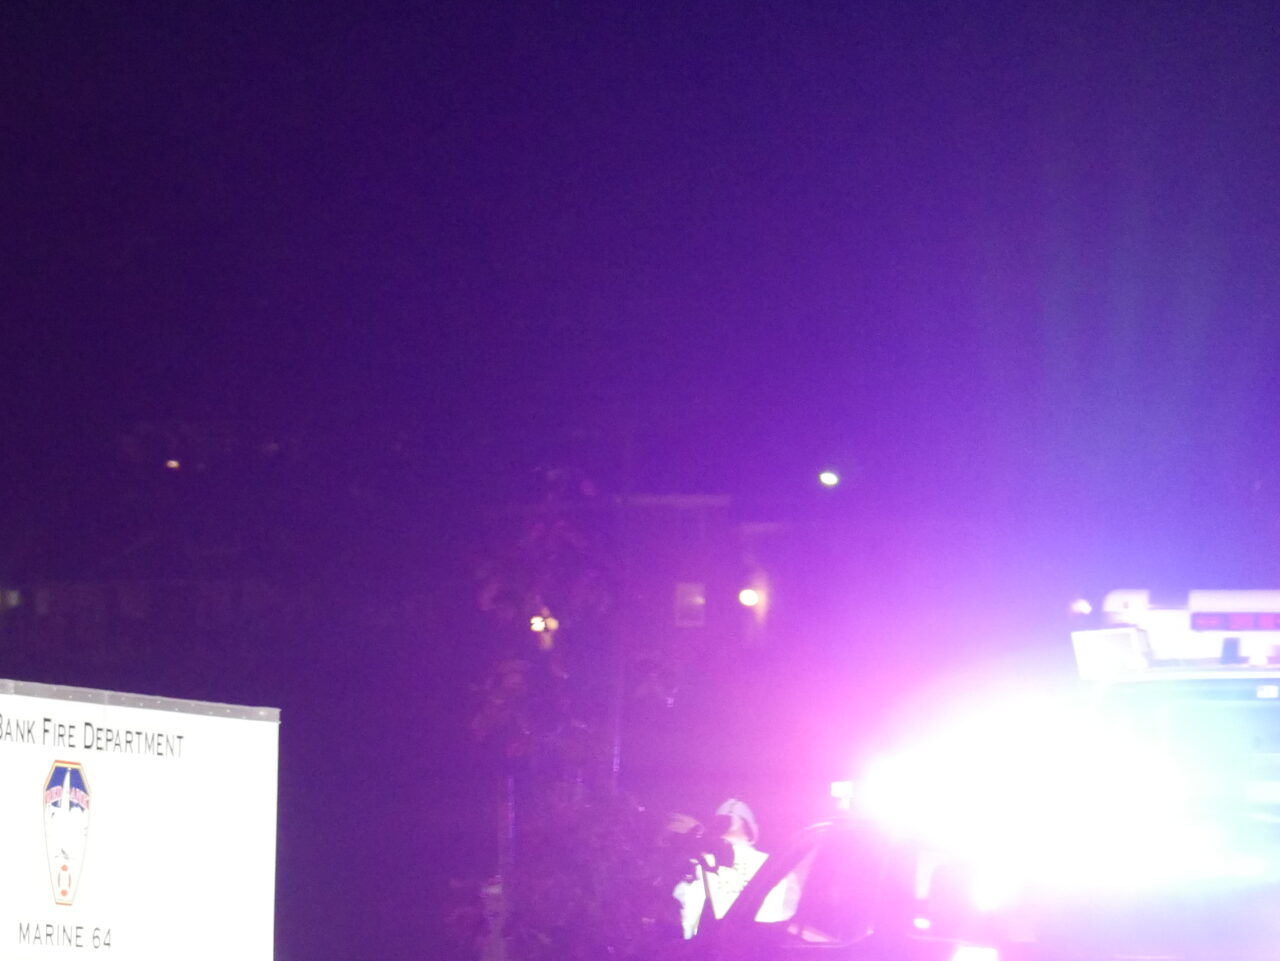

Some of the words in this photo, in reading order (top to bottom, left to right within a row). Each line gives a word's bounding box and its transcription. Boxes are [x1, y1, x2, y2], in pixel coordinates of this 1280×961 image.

[42, 717, 76, 748] FIRE
[83, 722, 184, 757] DEPARTMENT
[19, 922, 84, 948] MARINE
[92, 926, 112, 949] 64
